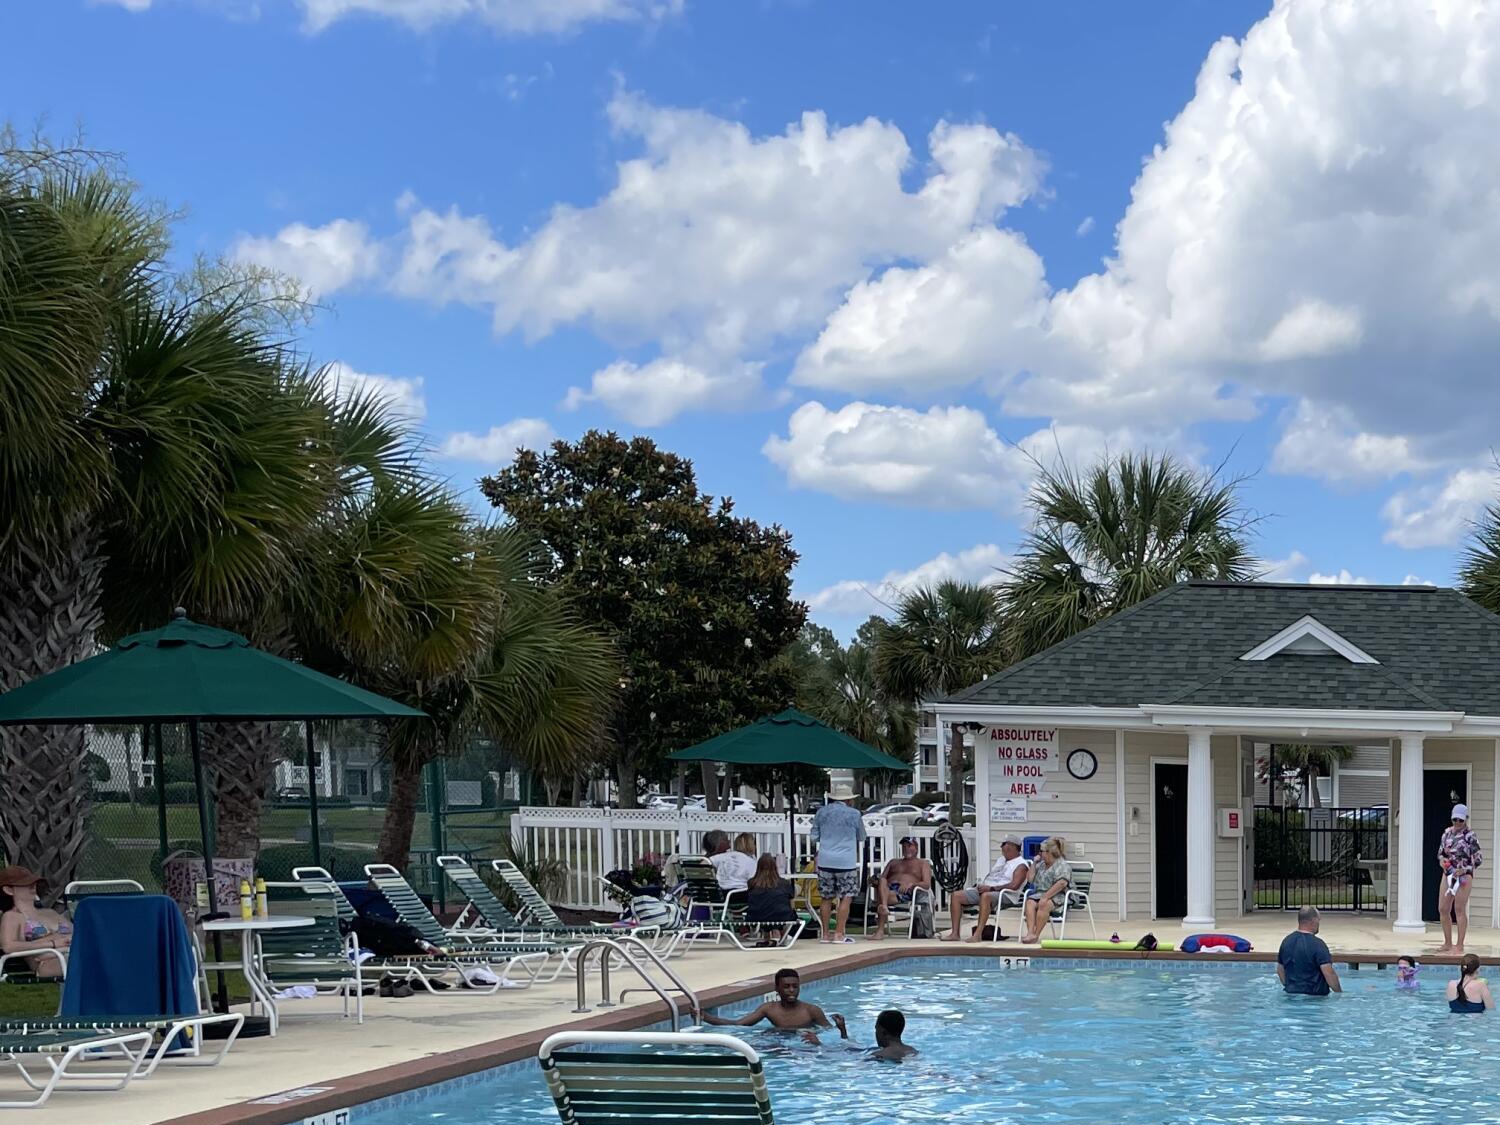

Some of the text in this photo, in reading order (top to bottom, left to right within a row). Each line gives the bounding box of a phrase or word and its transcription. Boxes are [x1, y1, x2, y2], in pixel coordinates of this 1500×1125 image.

[991, 728, 1055, 742] ABSOLUTELY
[998, 747, 1048, 760] NO GLASS
[1003, 764, 1043, 777] IN POOL
[1010, 783, 1037, 795] AREA
